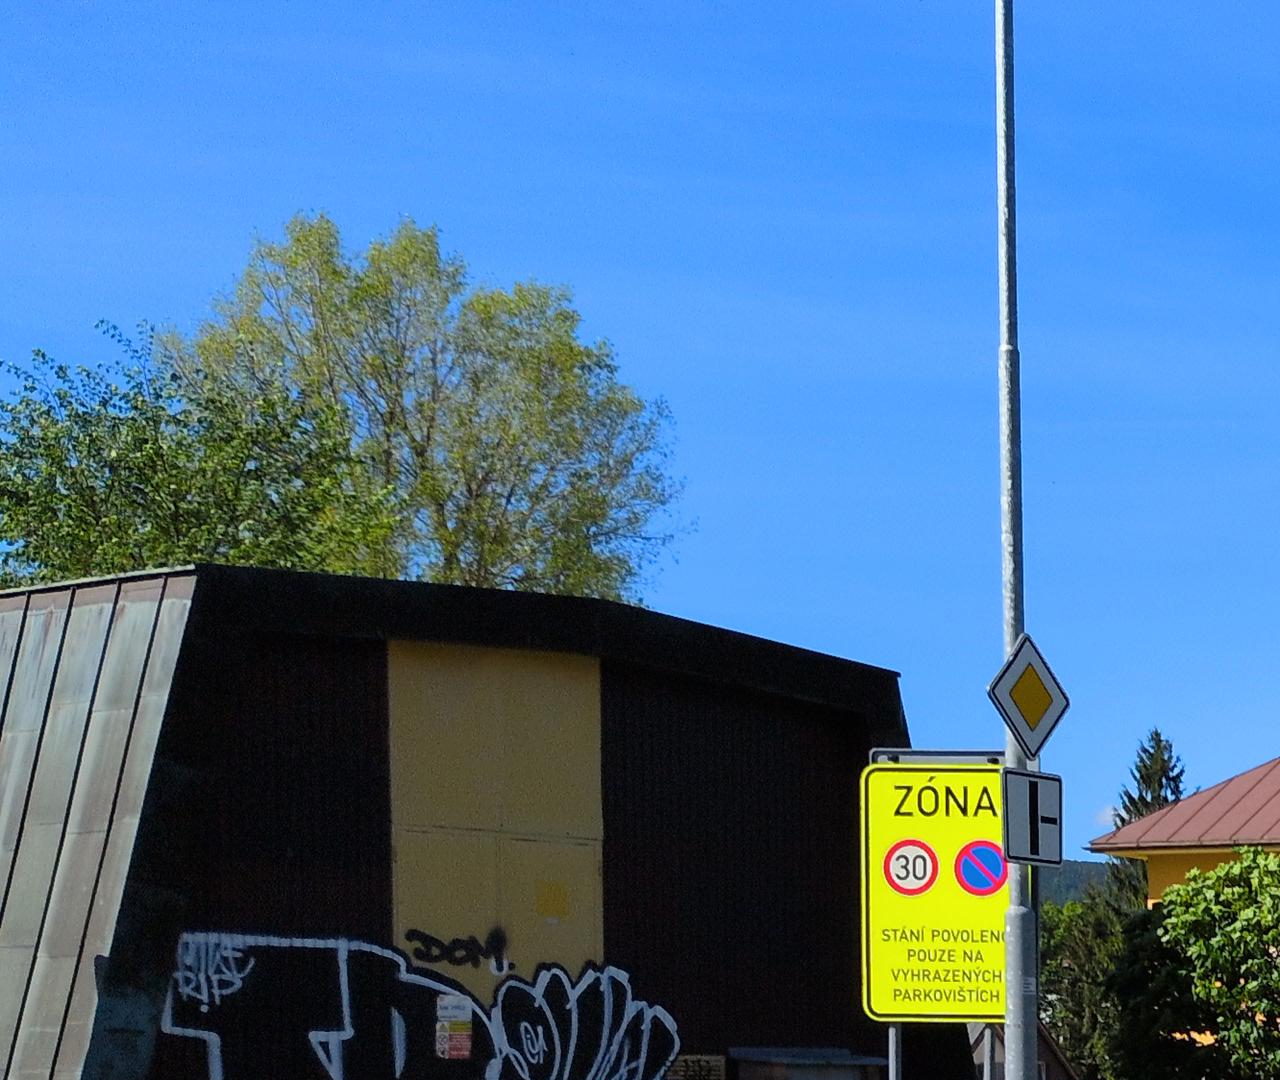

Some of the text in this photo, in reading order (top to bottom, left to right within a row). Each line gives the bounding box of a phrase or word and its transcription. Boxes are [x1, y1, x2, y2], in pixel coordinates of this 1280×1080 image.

[894, 776, 998, 817] ZÓNA
[895, 854, 927, 880] 30
[881, 926, 925, 942] STÁNÍ
[907, 949, 984, 963] POUZE NA
[891, 967, 1002, 983] VYHRAZENÝCH
[893, 986, 1000, 1003] PARKOVIŠTÍCH
